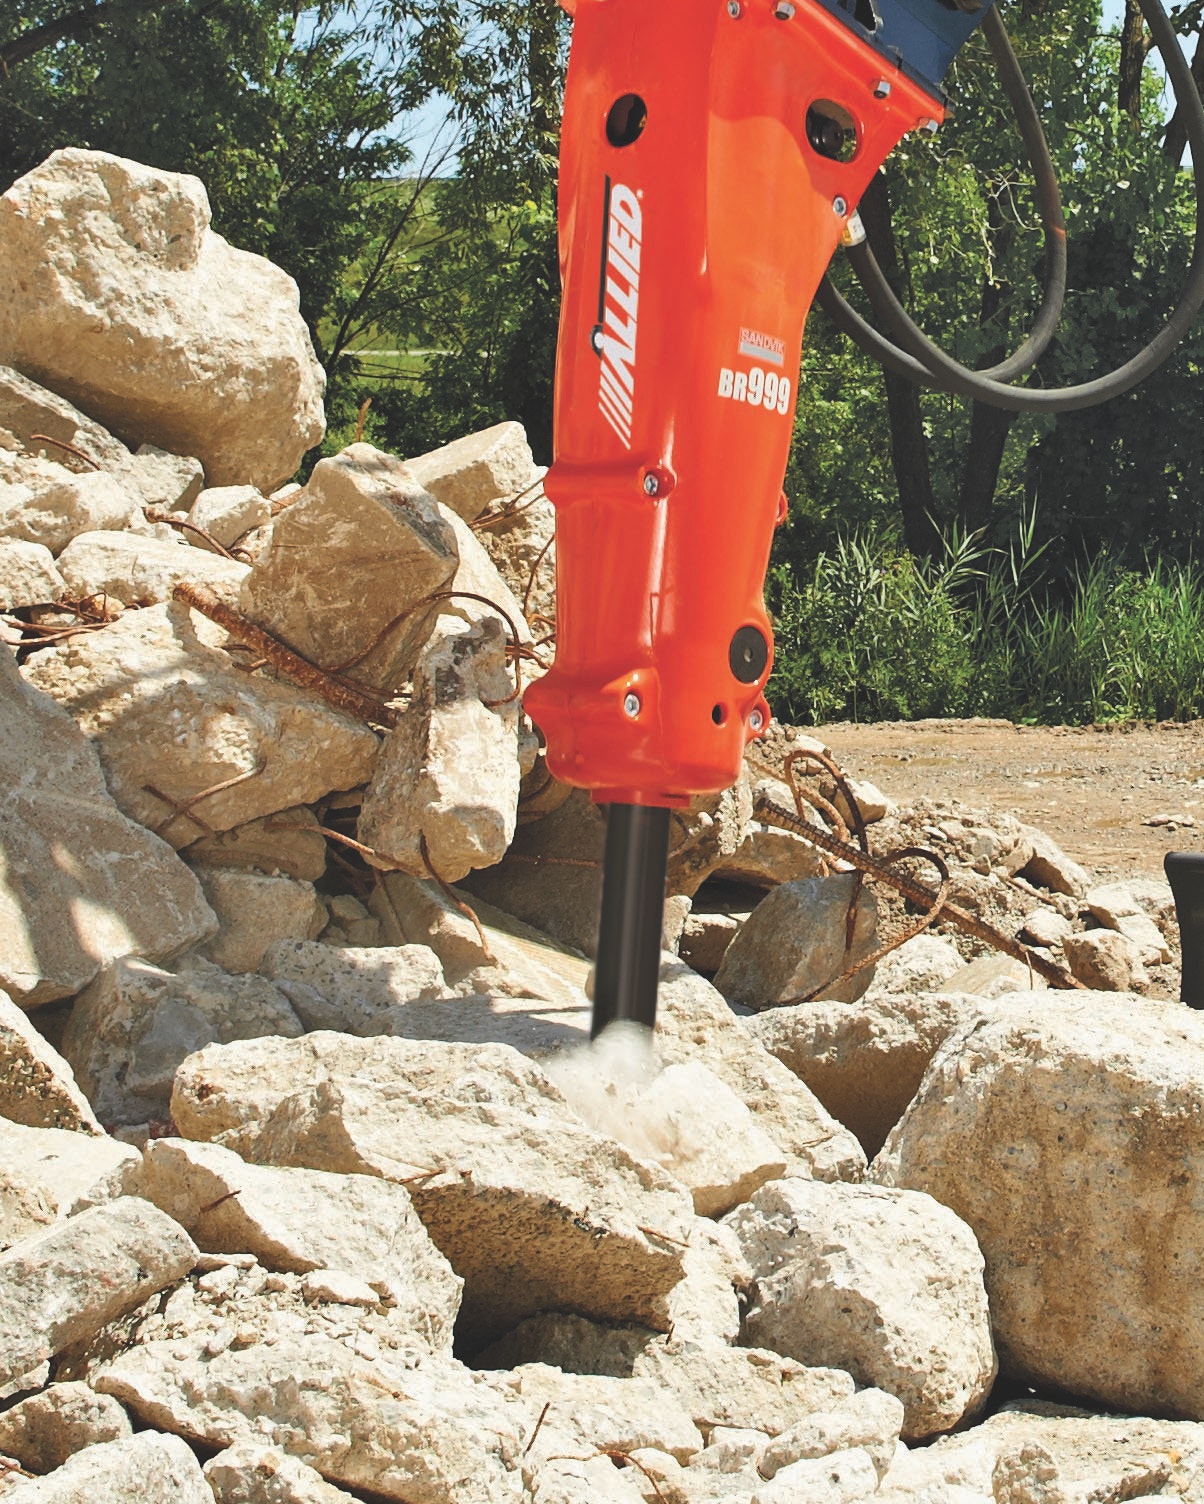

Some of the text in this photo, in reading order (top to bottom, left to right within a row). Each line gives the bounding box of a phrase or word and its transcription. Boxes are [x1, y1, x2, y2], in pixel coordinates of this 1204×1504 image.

[598, 183, 643, 448] ALLIED
[741, 328, 784, 354] SANDVIK
[718, 367, 791, 415] BR999
